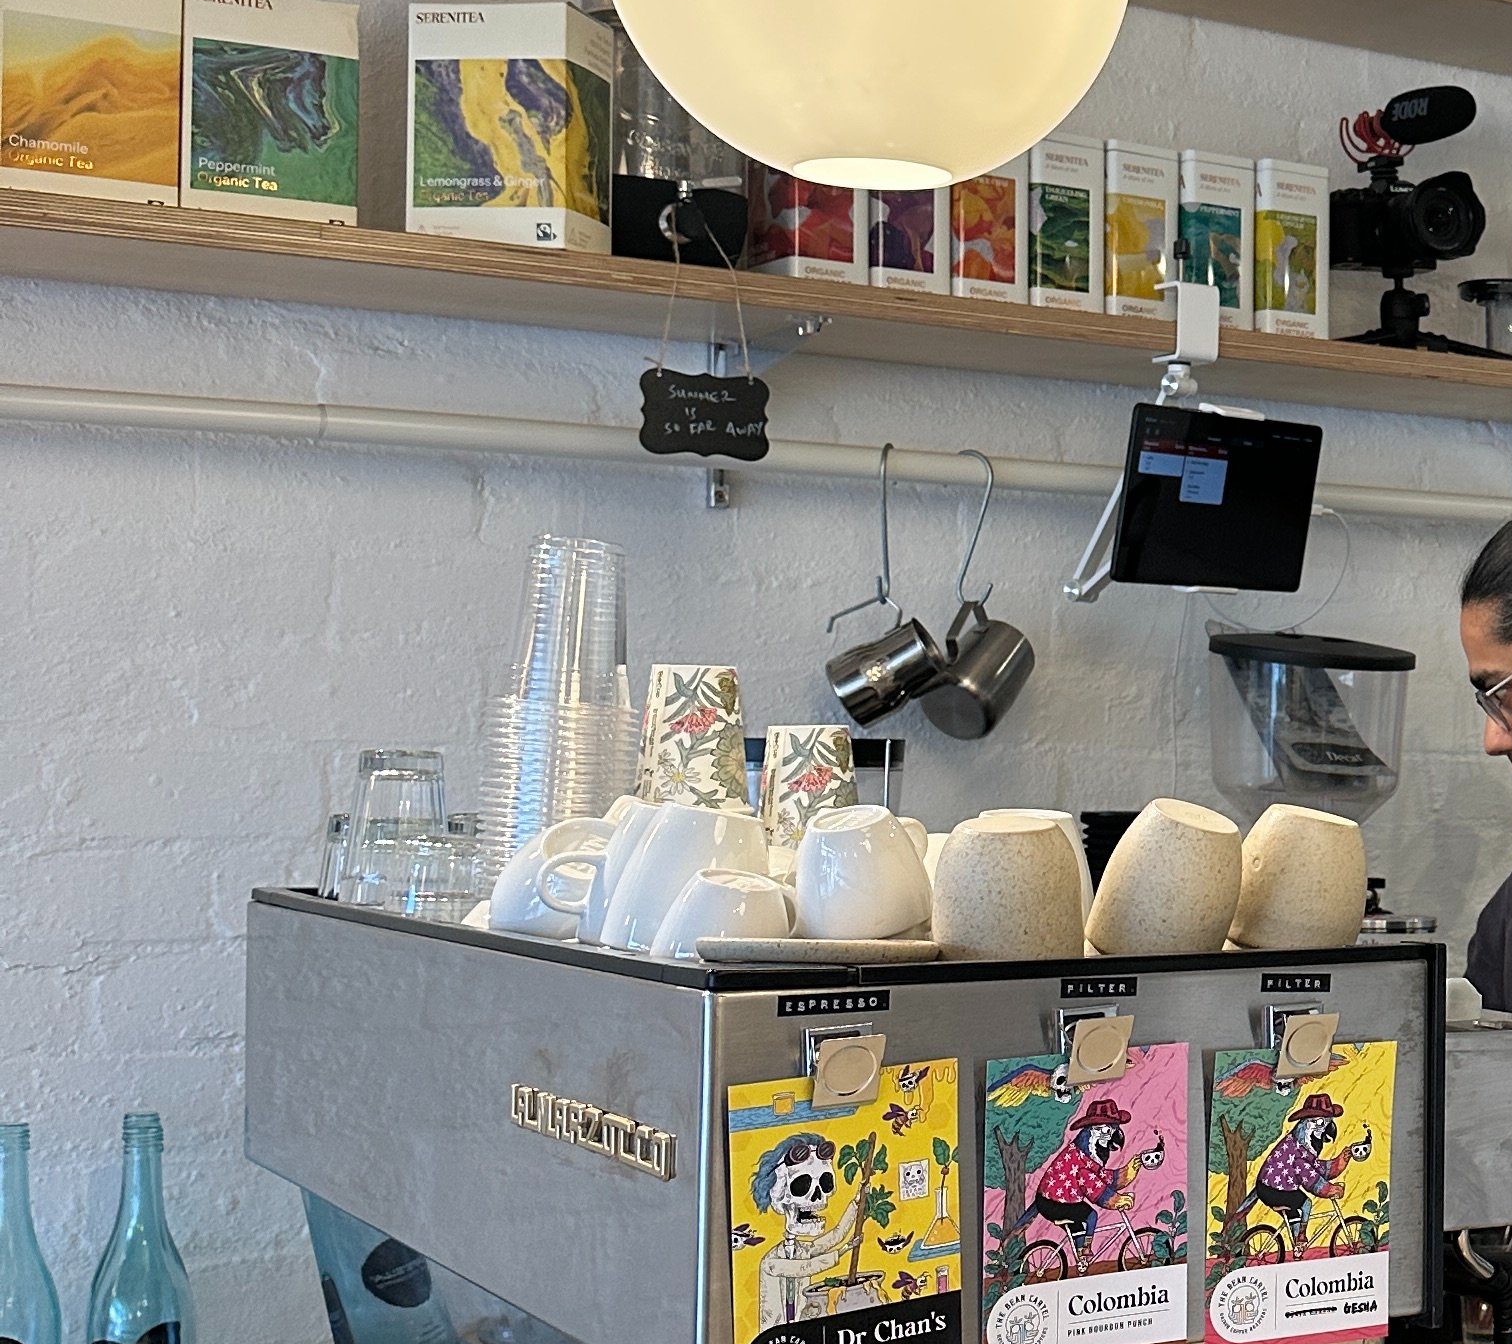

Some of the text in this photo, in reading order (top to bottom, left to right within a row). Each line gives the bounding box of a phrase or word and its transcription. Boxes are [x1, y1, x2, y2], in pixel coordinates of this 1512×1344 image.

[415, 11, 485, 24] SERENITEA
[8, 134, 89, 155] Chamomile
[68, 155, 94, 171] Tea
[198, 157, 276, 177] Peppermint
[197, 171, 278, 192] Organic Tea
[419, 175, 546, 189] Lemongrass & Ginger
[685, 407, 697, 420] IS
[664, 420, 764, 437] SO FAR AWAY
[1266, 978, 1321, 990] FILTER
[785, 997, 878, 1012] ESPRESSO
[1218, 1291, 1228, 1307] THE
[1227, 1276, 1247, 1291] BEAN
[1285, 1270, 1375, 1299] Colombia
[1068, 1285, 1170, 1316] Colombia
[1344, 1300, 1378, 1314] GESHA
[996, 1294, 1050, 1329] THE BEAN CARTEL
[874, 1311, 947, 1343] Chan's
[1067, 1317, 1153, 1338] PINK BOURBON PUNCH
